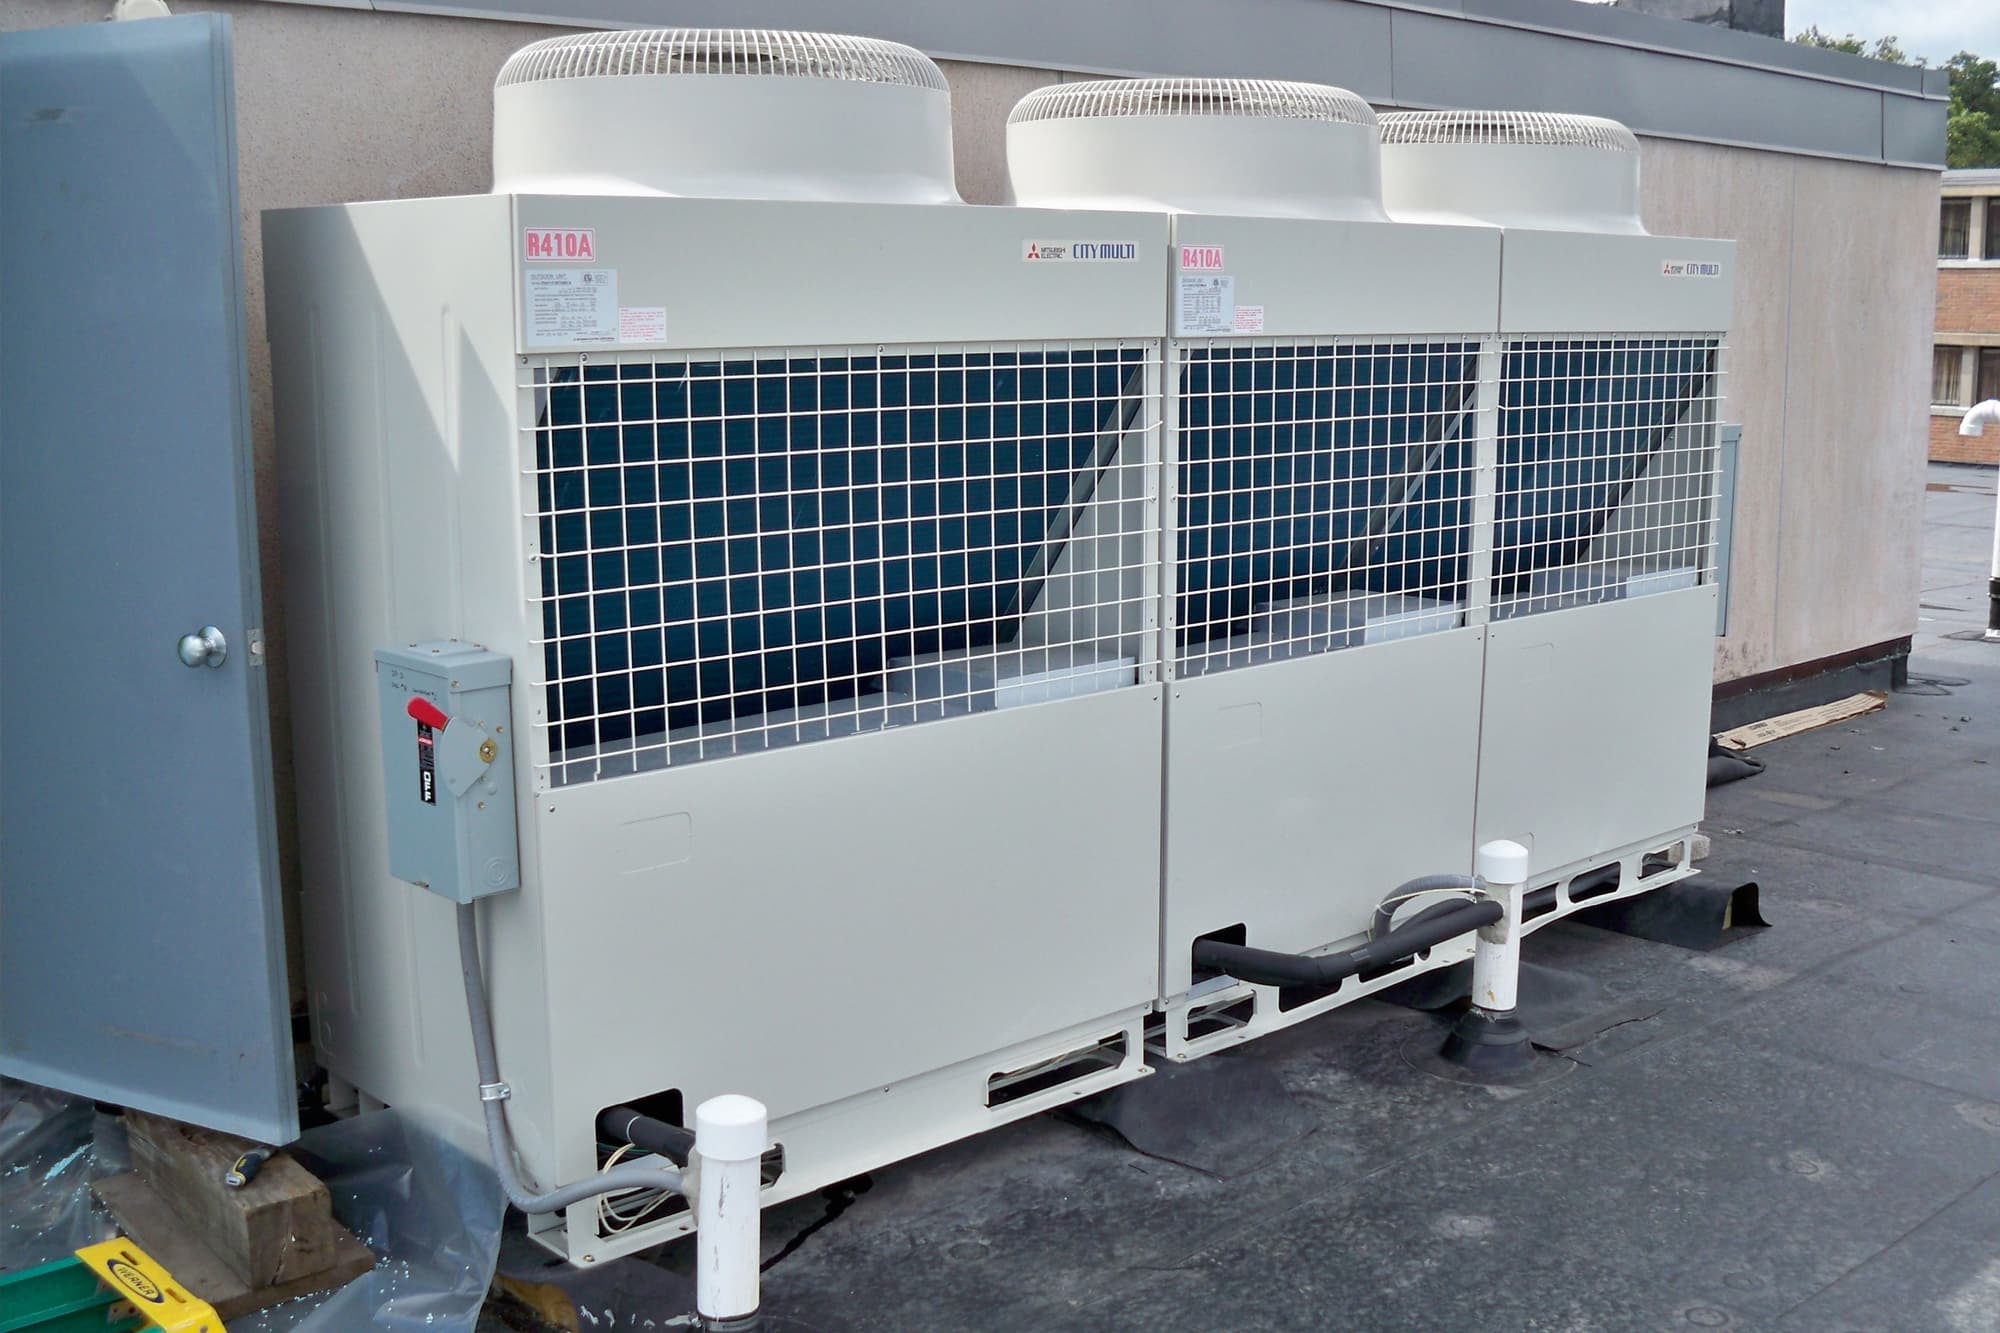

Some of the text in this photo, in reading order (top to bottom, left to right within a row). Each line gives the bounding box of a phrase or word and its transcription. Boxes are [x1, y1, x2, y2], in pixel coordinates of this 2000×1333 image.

[527, 232, 593, 257] R410A
[1073, 243, 1135, 259] CITY MULTI
[1183, 248, 1222, 268] R410A
[1686, 263, 1699, 275] CITY
[423, 771, 432, 802] OFF
[117, 1266, 155, 1295] WERNER
